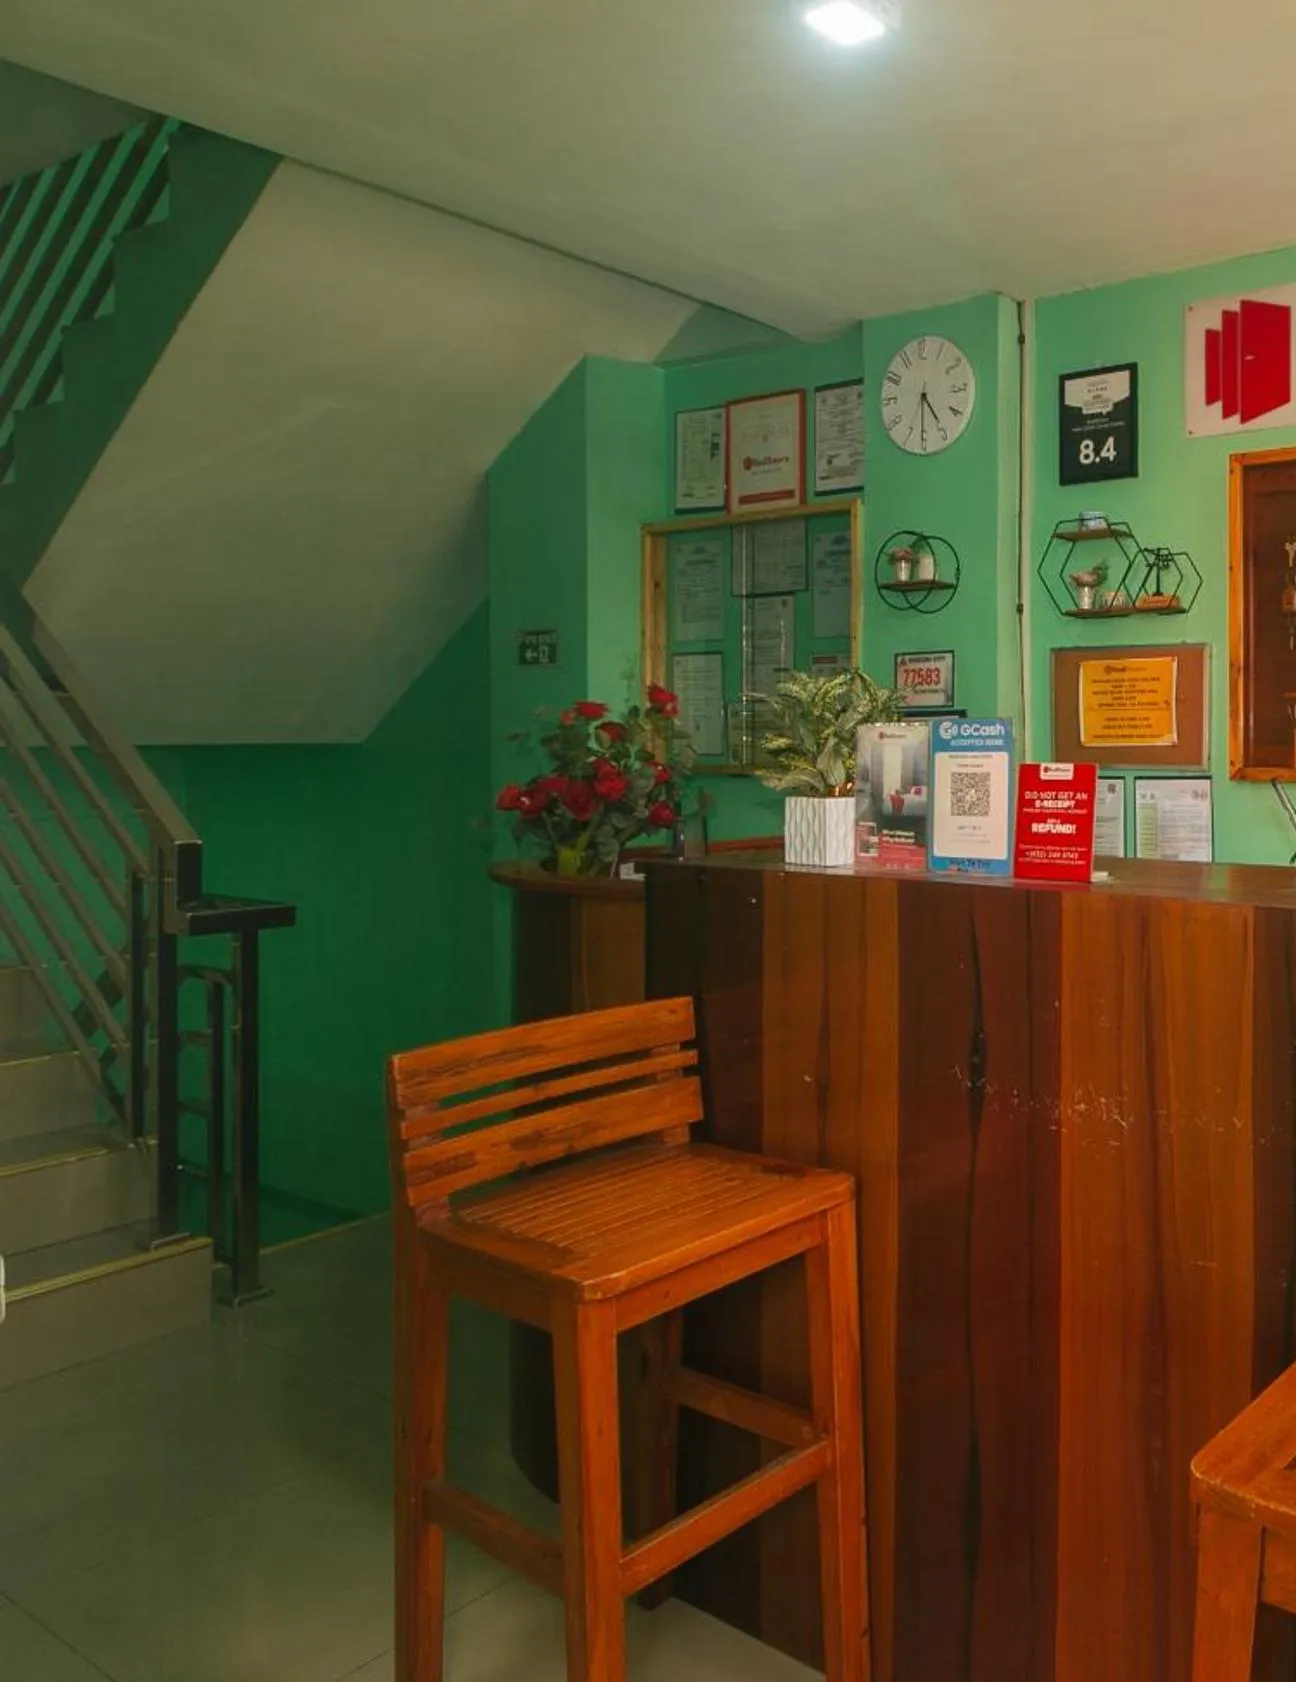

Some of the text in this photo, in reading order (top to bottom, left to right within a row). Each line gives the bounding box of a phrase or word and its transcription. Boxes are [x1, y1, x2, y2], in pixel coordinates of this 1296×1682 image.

[1079, 435, 1118, 465] 8.4
[960, 722, 1006, 737] GCash
[1031, 822, 1077, 835] REFUND!
